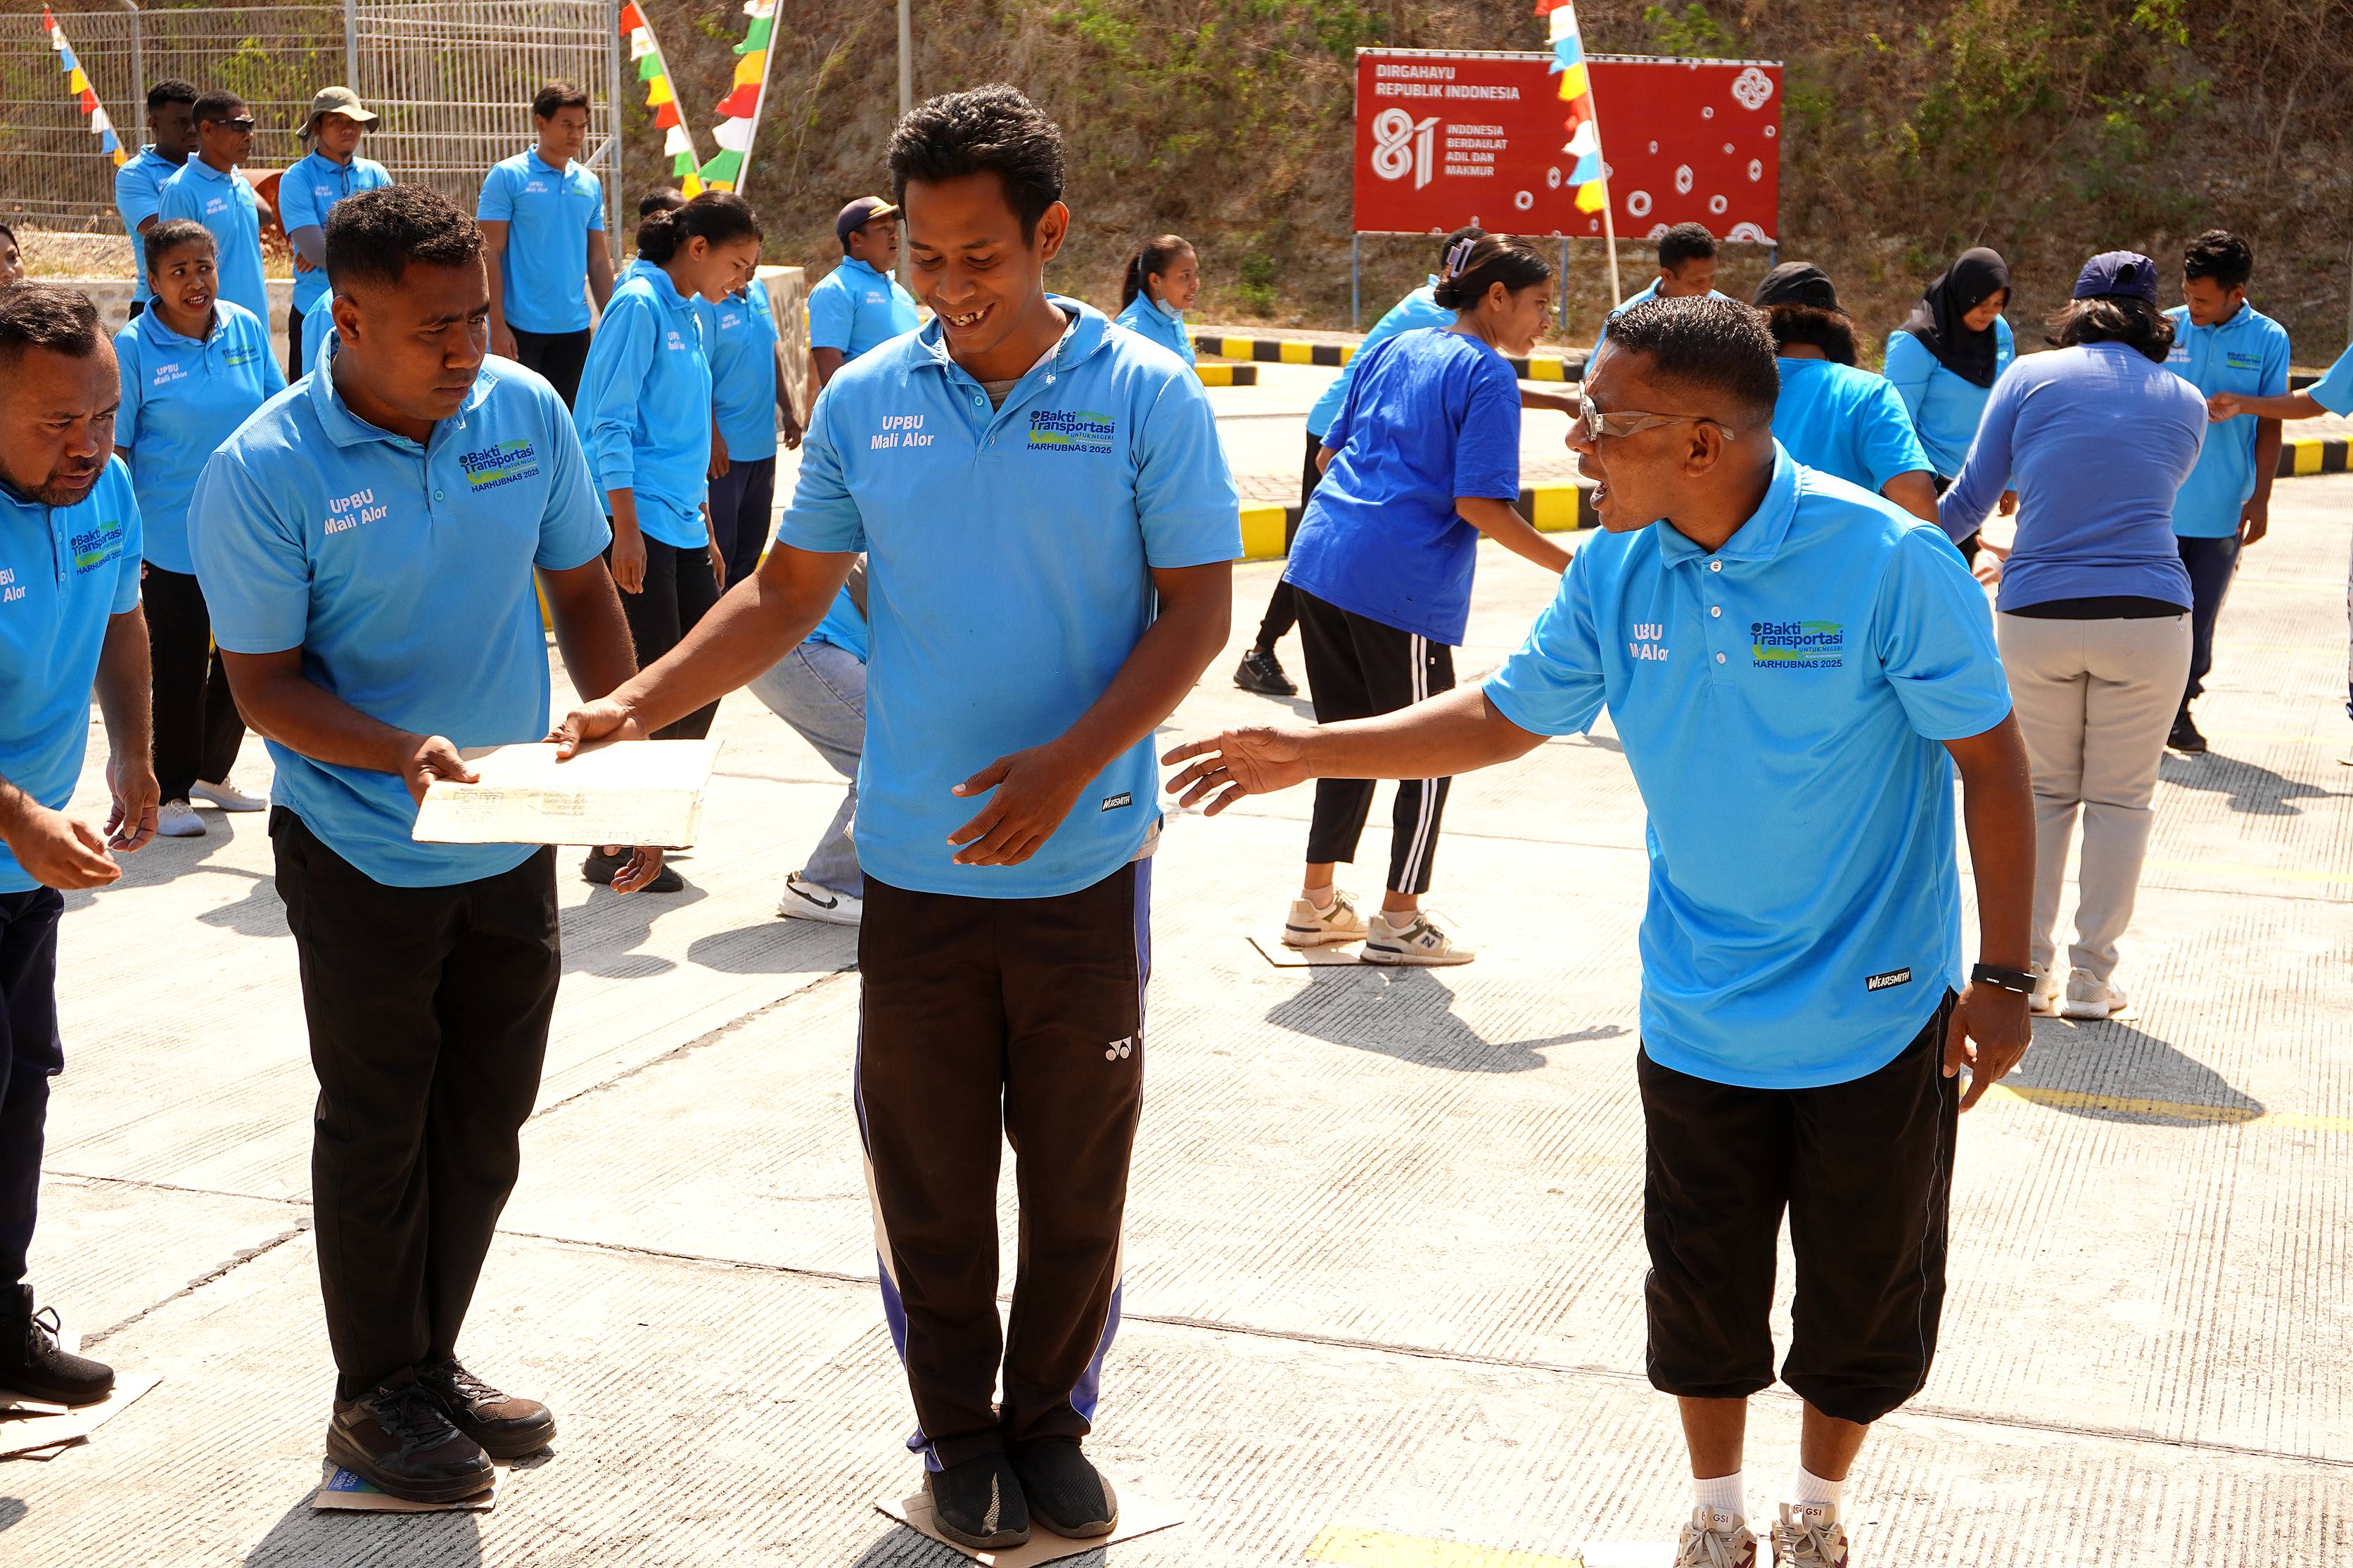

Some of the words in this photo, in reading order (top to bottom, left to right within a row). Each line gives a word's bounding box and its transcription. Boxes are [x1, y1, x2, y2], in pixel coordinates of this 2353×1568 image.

[1376, 64, 1455, 79] DIRGAHAYU
[1375, 82, 1443, 97] REPUBLIK
[1445, 85, 1520, 100] INDONESIA
[1446, 124, 1504, 136] INDONESIA
[1371, 108, 1441, 191] 81
[1446, 137, 1508, 150] BERDAULAT
[1445, 151, 1470, 162] ADIL
[1472, 152, 1495, 163] DAN
[1445, 165, 1495, 177] MAKMUR
[882, 414, 924, 430] UPBU
[1040, 410, 1076, 423] Bakti
[1030, 419, 1115, 434] Transportasi
[871, 433, 899, 450] Mali
[902, 432, 934, 447] Alor
[1027, 443, 1087, 452] HARHUBNAS
[461, 444, 535, 473] Transportasi
[467, 445, 501, 464] Bakti
[471, 475, 523, 492] HARHUBNAS
[523, 468, 540, 478] 2025
[329, 488, 374, 514] UPBU
[324, 514, 357, 535] Mali
[362, 505, 387, 524] Alor
[76, 526, 101, 545] Bakti
[111, 550, 121, 559] 202
[0, 568, 15, 585] BU
[4, 586, 25, 603] Alor
[1763, 621, 1801, 635] Bakti
[1751, 630, 1843, 649] Transportasi
[1753, 660, 1818, 668] HARHUBNAS
[1868, 971, 1910, 990] WEARSMITH
[1713, 1514, 1728, 1524] GSI
[1806, 1508, 1822, 1516] GSI
